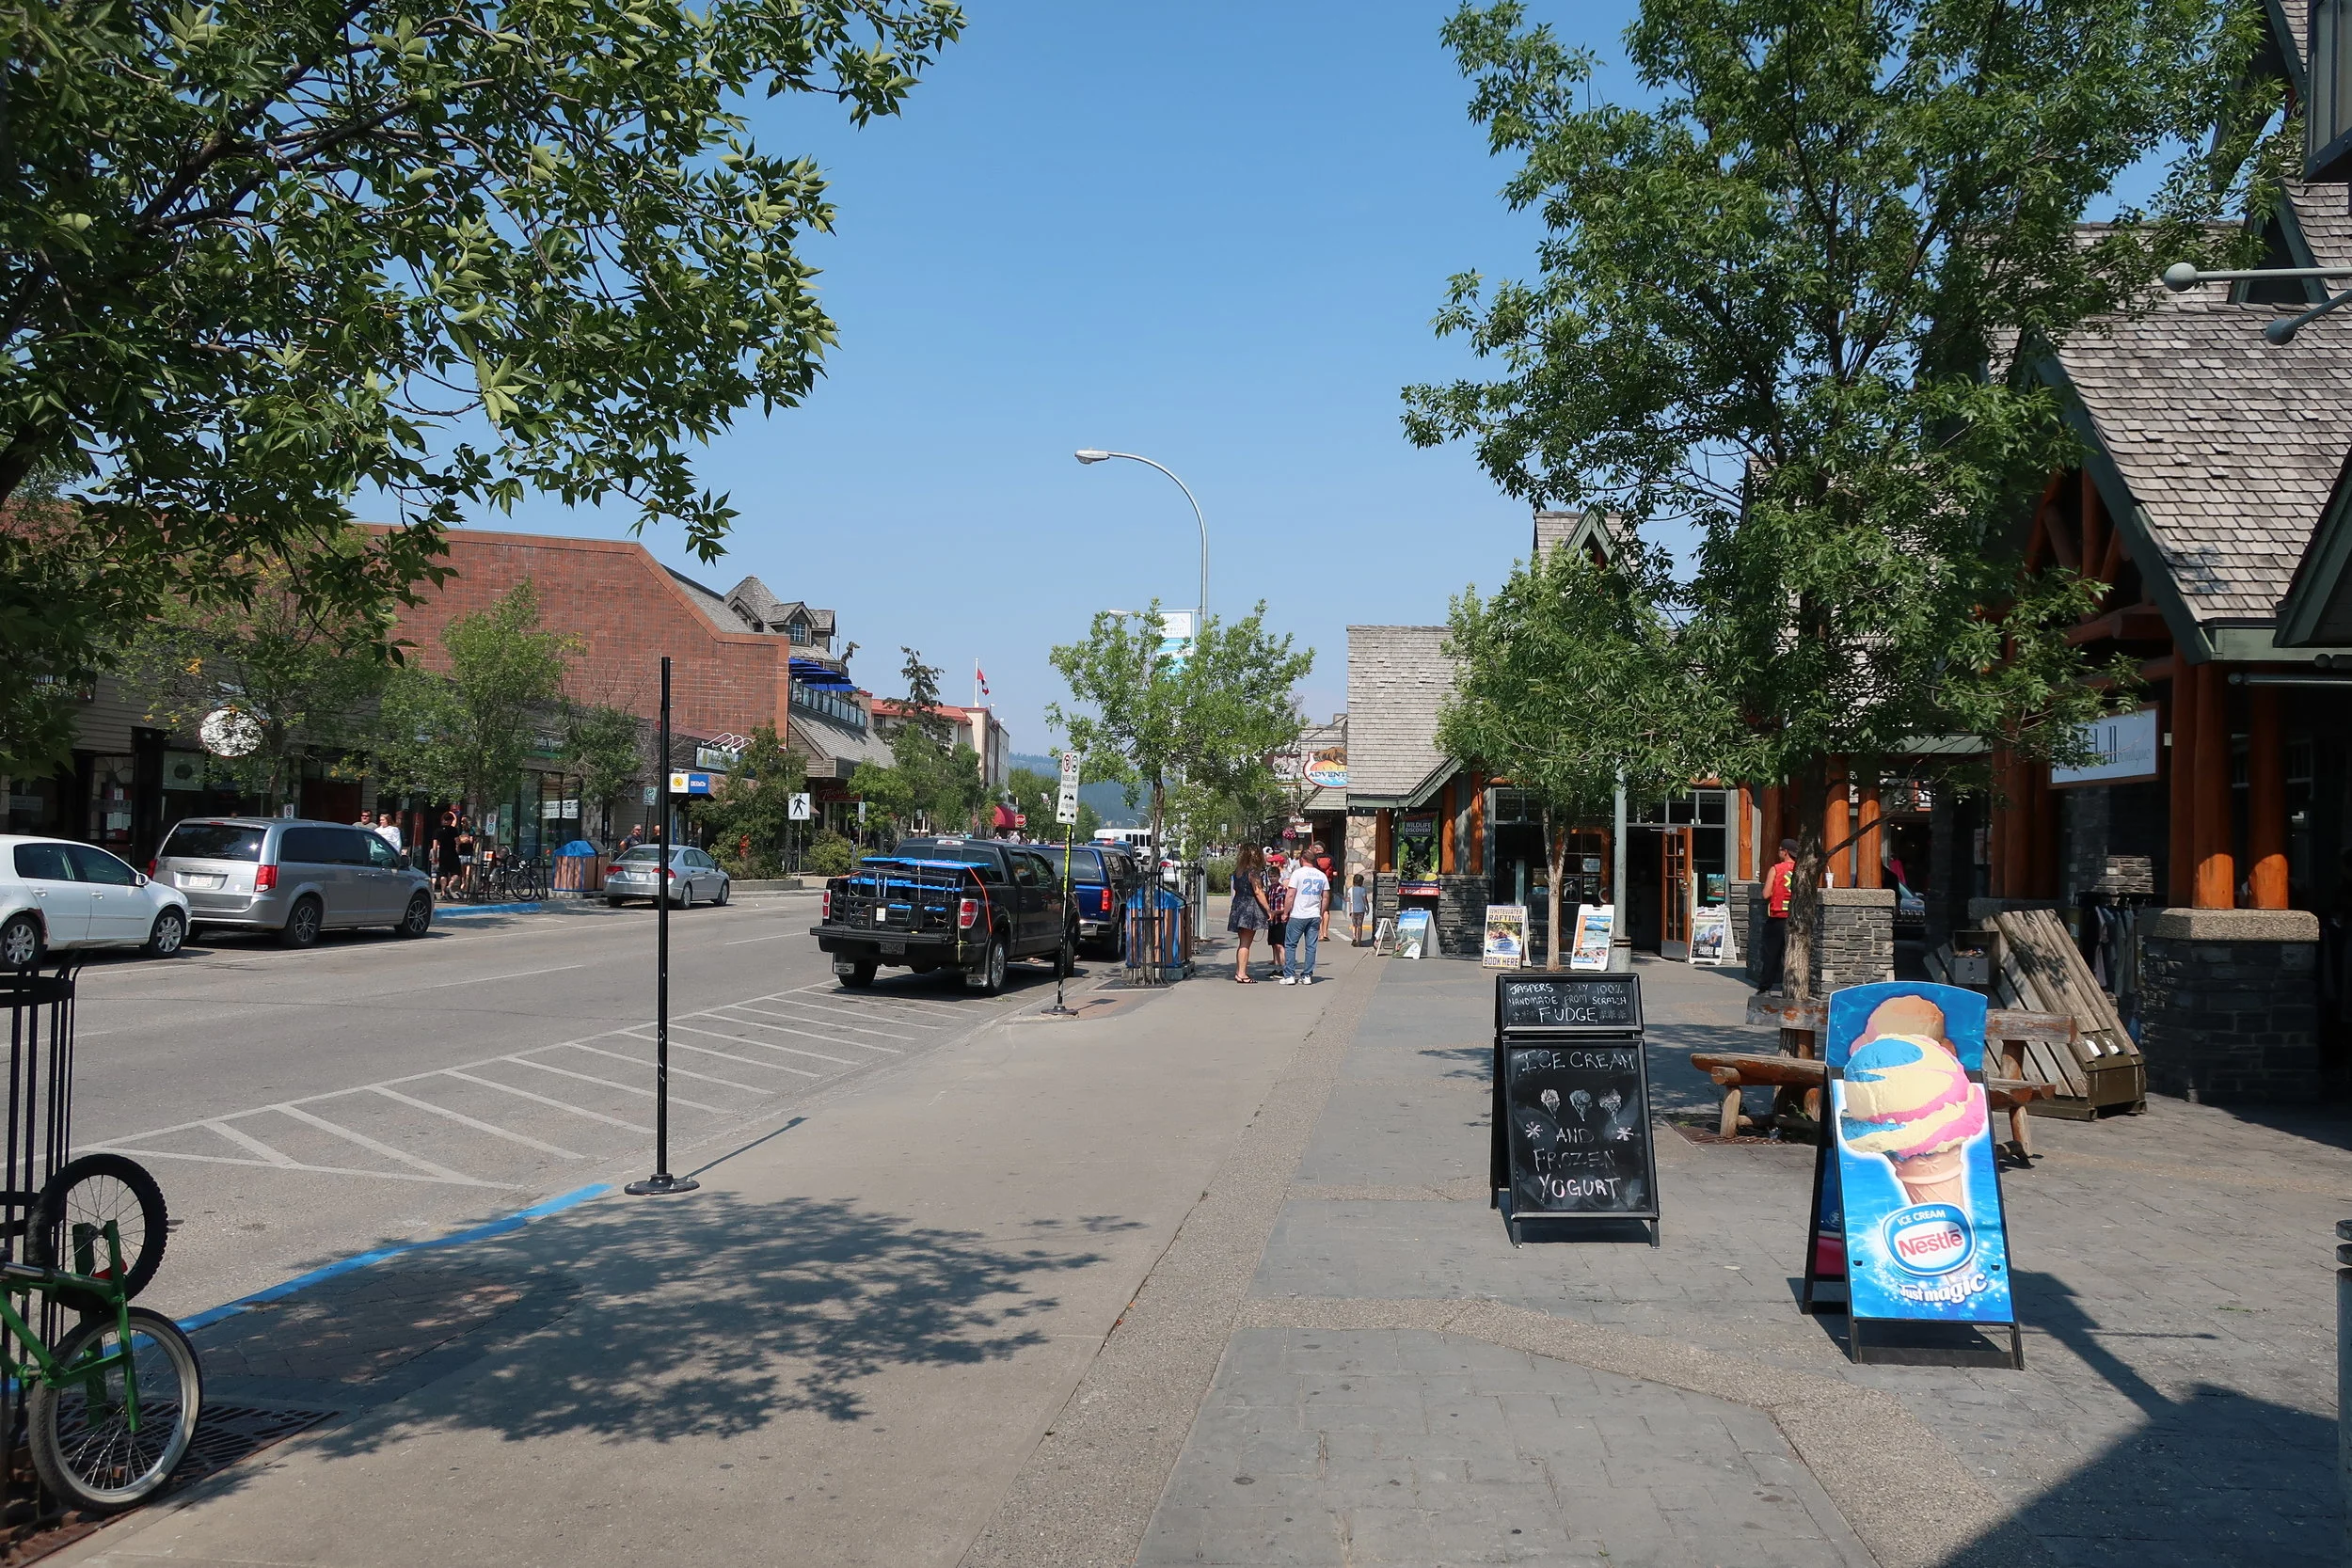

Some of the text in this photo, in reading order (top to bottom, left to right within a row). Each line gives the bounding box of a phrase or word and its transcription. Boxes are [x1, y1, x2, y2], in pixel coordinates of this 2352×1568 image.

[1301, 879, 1324, 895] 23
[1484, 957, 1518, 966] BOOK HERE
[1509, 983, 1554, 995] JASPERS
[1508, 996, 1558, 1006] HANDMADE
[1564, 994, 1587, 1006] FROM
[1538, 1006, 1597, 1024] FUDGE
[1518, 1049, 1634, 1072] ICE CREAM
[1556, 1127, 1594, 1144] AND
[1533, 1148, 1615, 1172] FROZEN
[1538, 1173, 1621, 1201] YOGURT
[1897, 1209, 1947, 1227] ICE CREAM
[1924, 1273, 1988, 1304] magic
